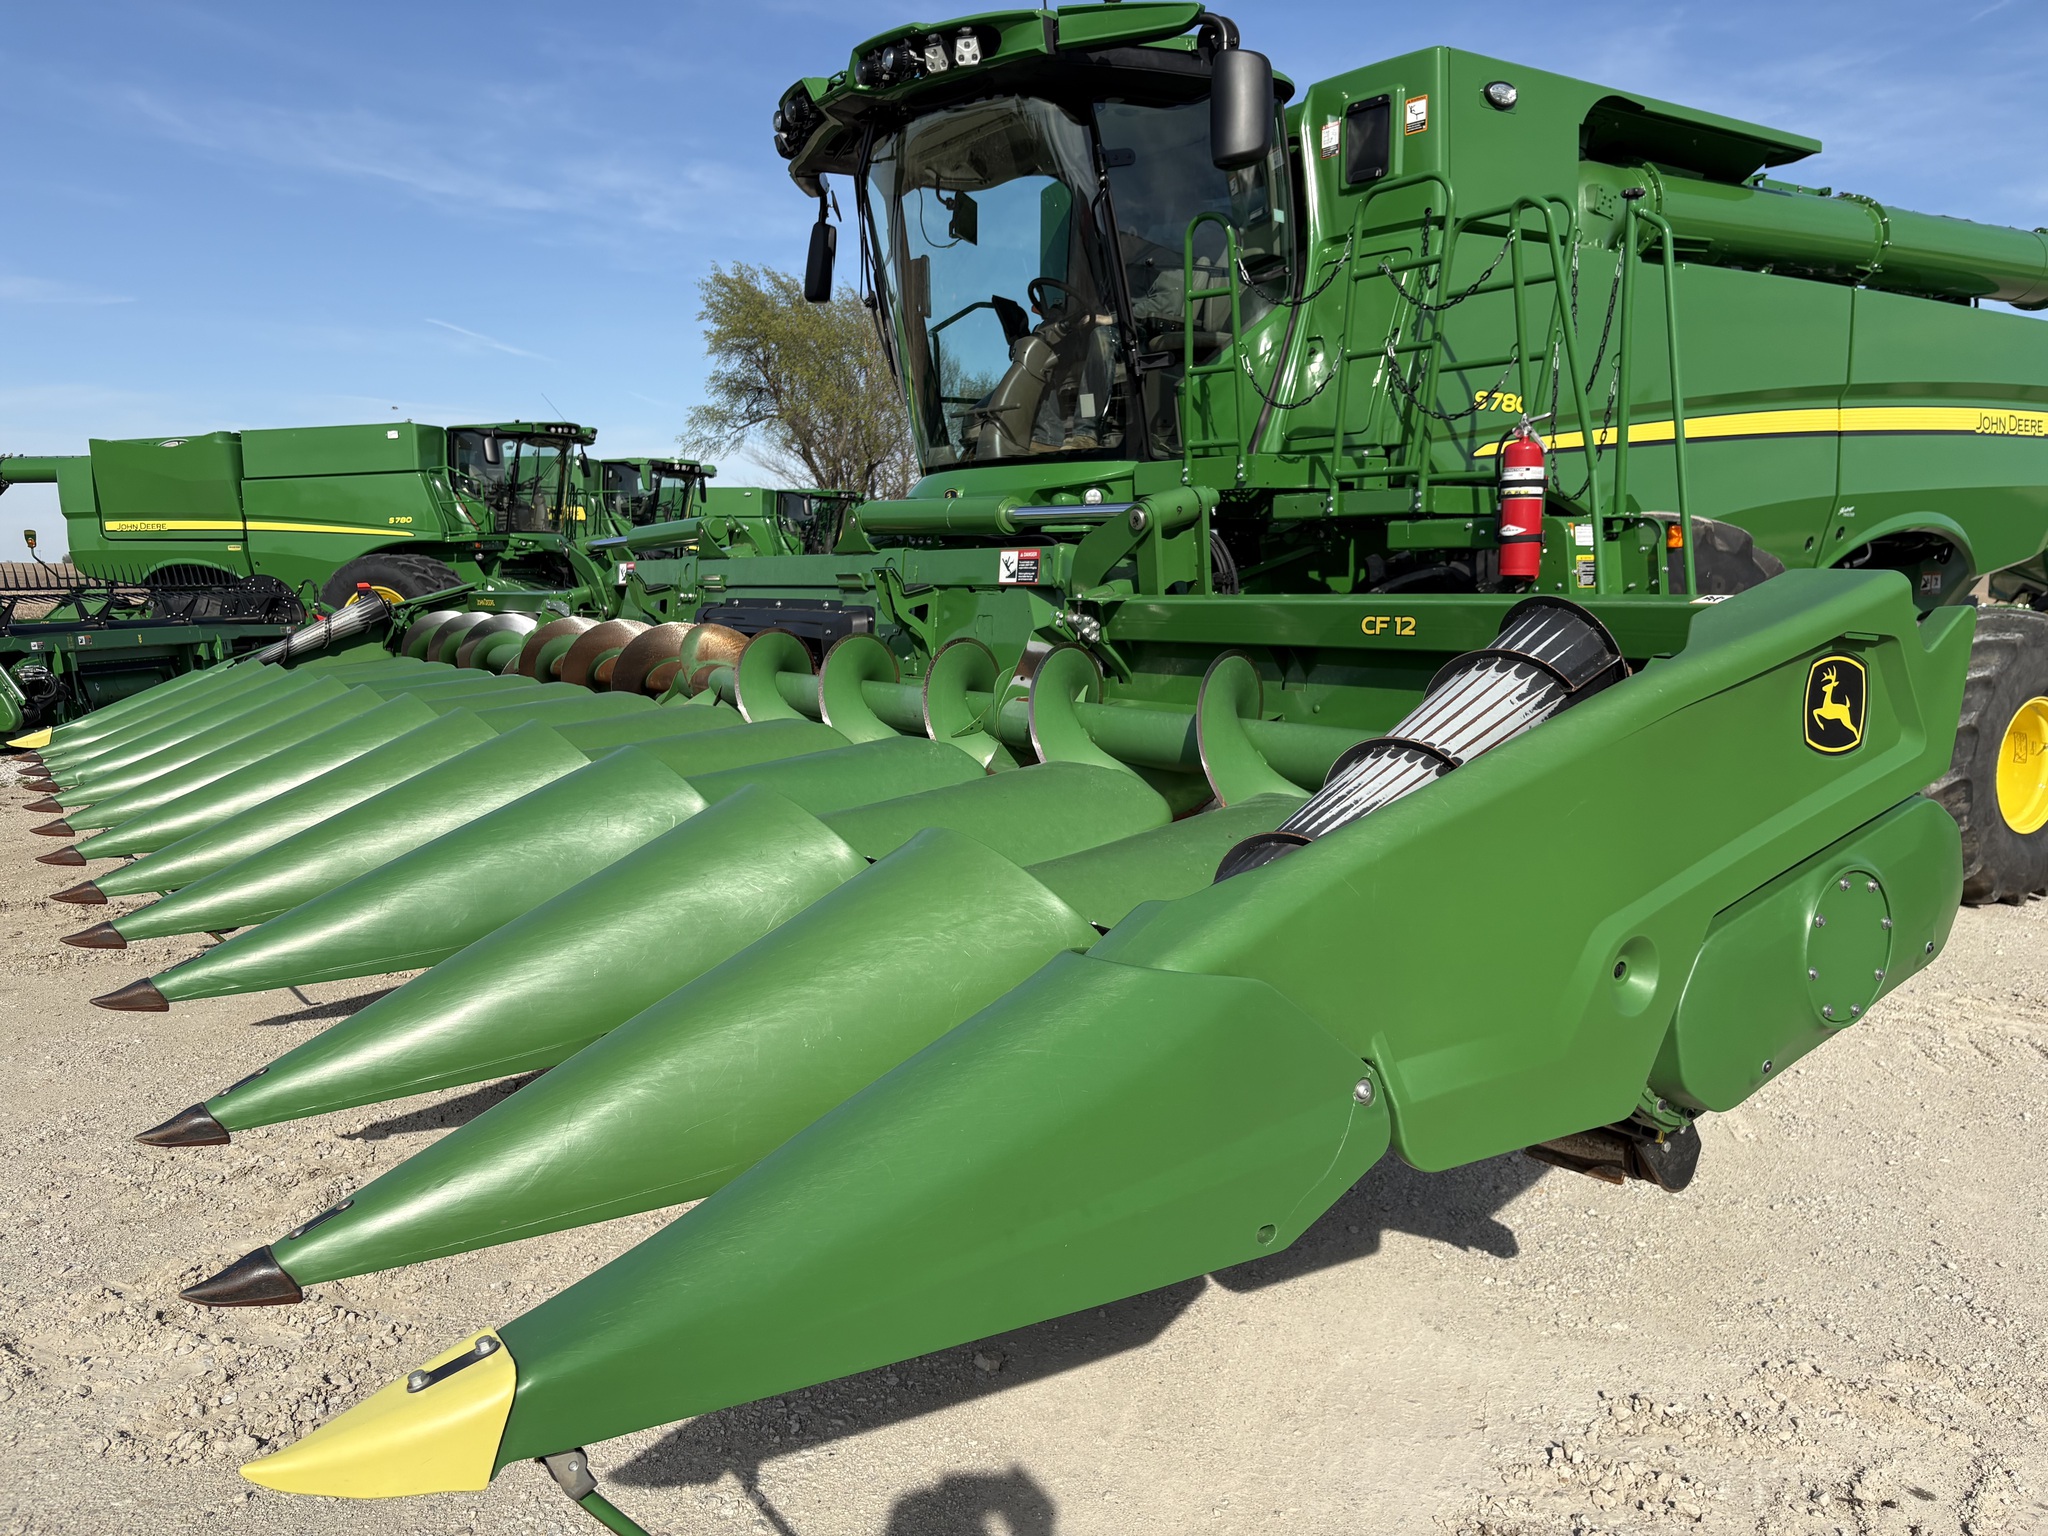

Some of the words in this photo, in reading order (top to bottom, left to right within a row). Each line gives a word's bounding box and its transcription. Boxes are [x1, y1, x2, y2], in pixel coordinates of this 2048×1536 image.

[1975, 412, 2007, 431] JOHN
[2009, 414, 2044, 434] DEERE
[116, 522, 139, 530] JOHN
[139, 522, 167, 530] DEERE
[388, 516, 413, 524] S780
[1361, 615, 1391, 635] CF
[1394, 616, 1417, 636] 12
